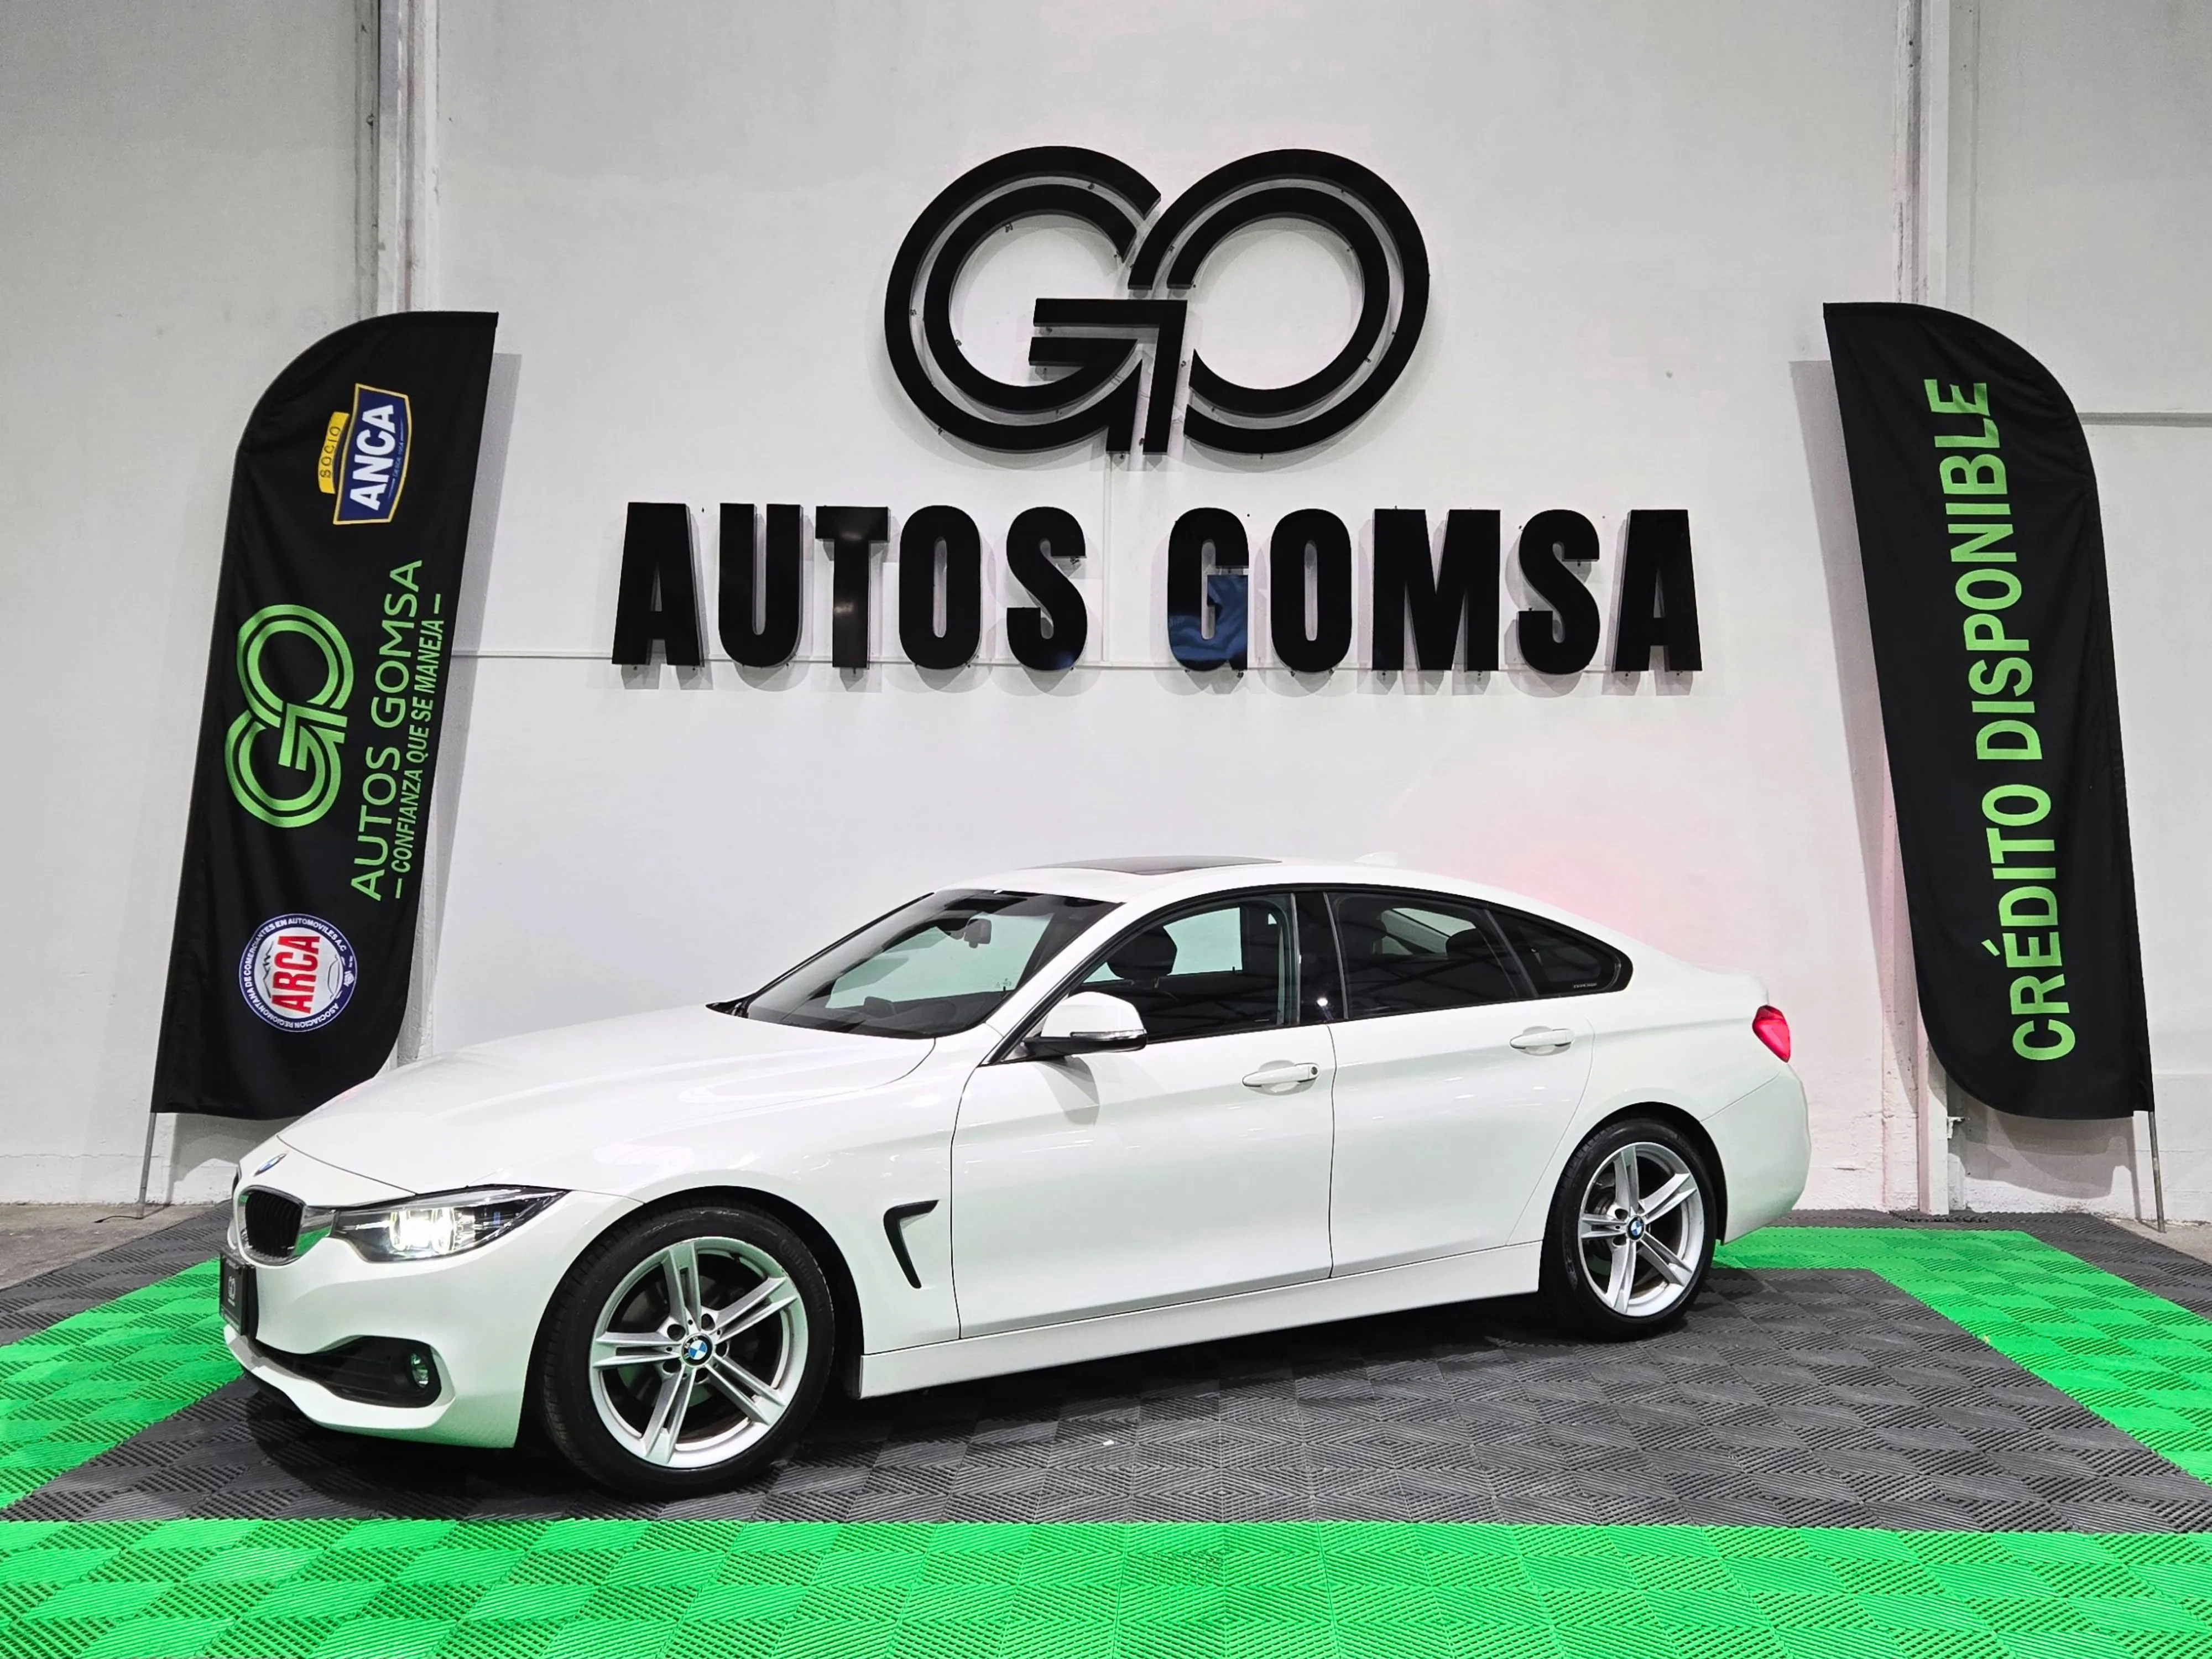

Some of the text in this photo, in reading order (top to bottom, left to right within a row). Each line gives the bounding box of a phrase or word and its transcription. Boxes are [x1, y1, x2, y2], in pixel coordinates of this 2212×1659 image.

[320, 425, 340, 478] SOCIO
[349, 404, 396, 510] ANCA
[612, 502, 1703, 675] AUTOS GOMSA
[350, 560, 422, 901] AUTOS GOMSA
[390, 619, 444, 873] CONFIANZA QUE SE MANEJA
[1924, 379, 2076, 1061] CRÉDITO DISPONIBLE
[274, 918, 288, 928] EN
[287, 917, 338, 941] AUTOMOVILES
[244, 977, 252, 988] DE
[272, 936, 321, 1014] ARCA
[294, 1002, 340, 1028] ASOCIACION
